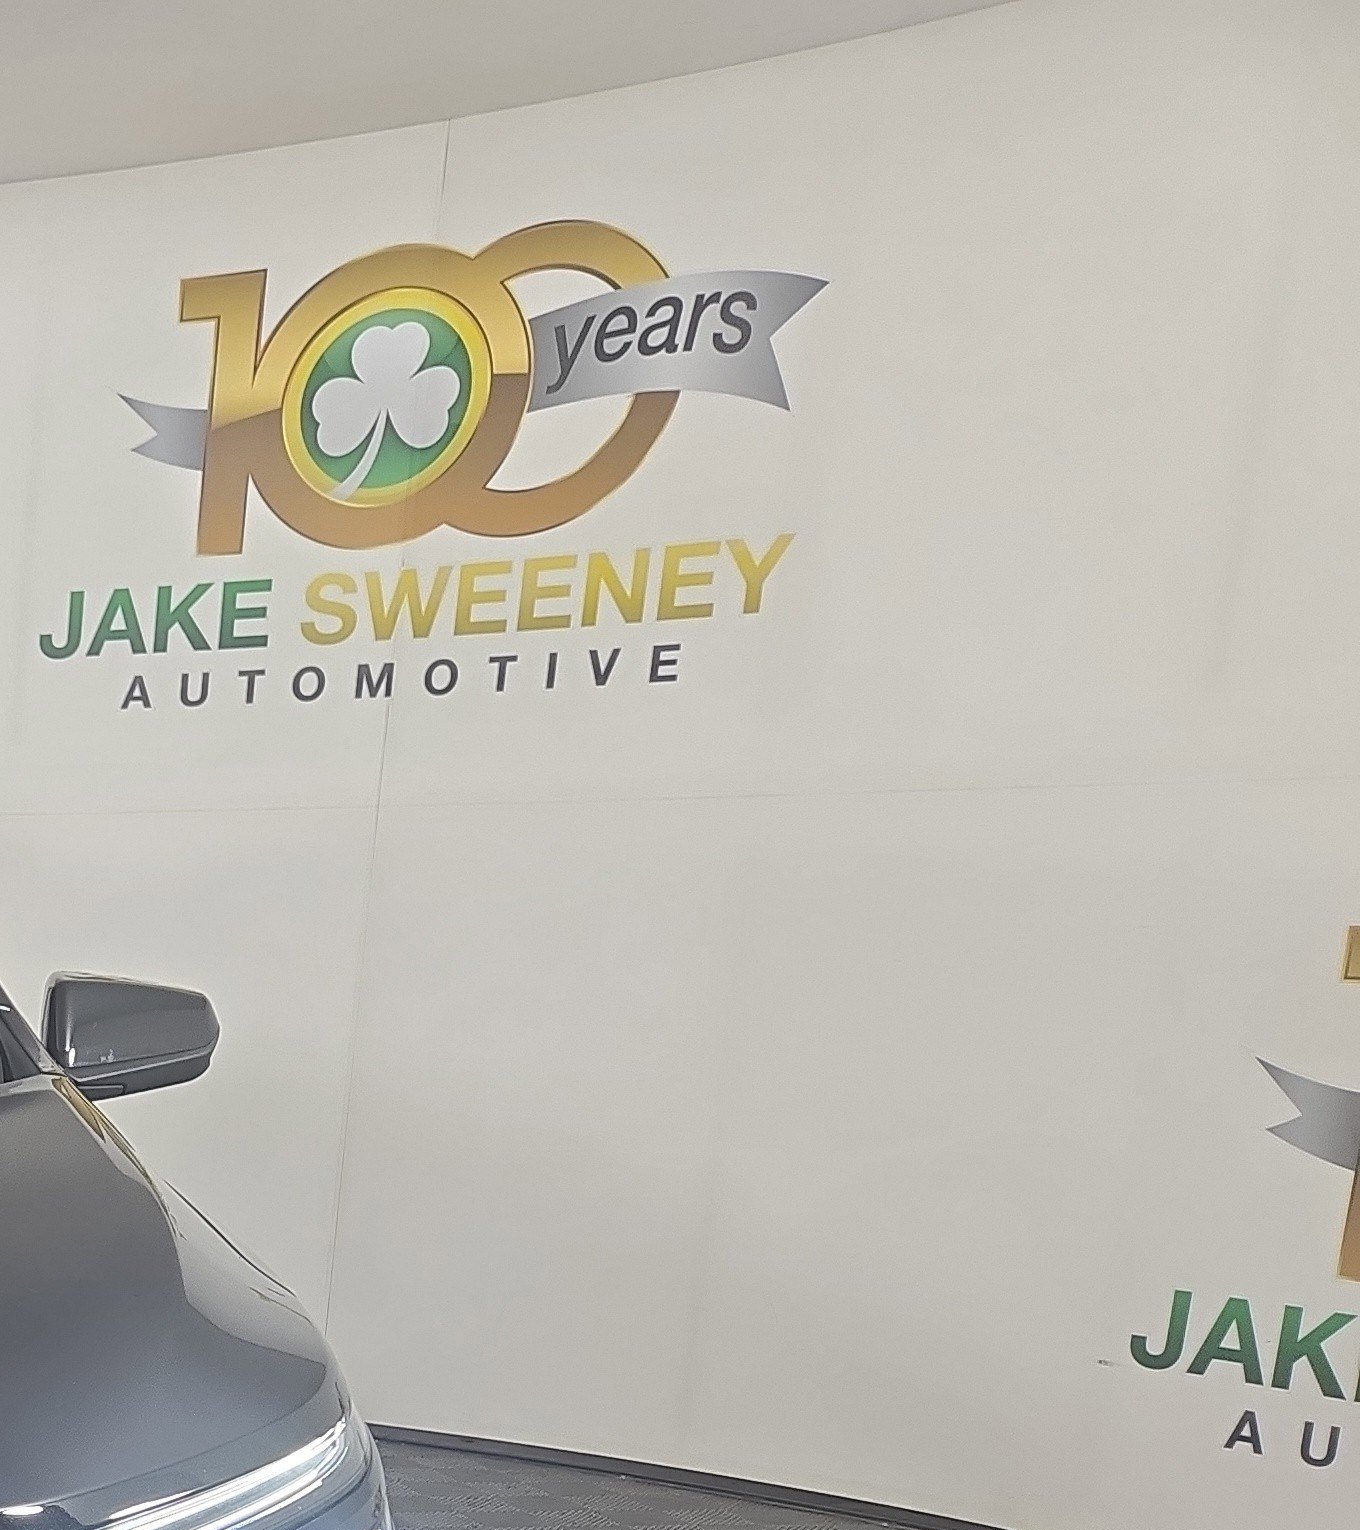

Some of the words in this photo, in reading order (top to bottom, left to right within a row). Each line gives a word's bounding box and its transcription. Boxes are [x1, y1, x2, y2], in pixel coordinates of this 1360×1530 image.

[546, 289, 758, 395] years
[38, 578, 273, 660] JAKE
[299, 533, 796, 648] SWEENEY
[120, 643, 682, 711] AUTOMOTIVE
[1129, 1289, 1360, 1402] JAK
